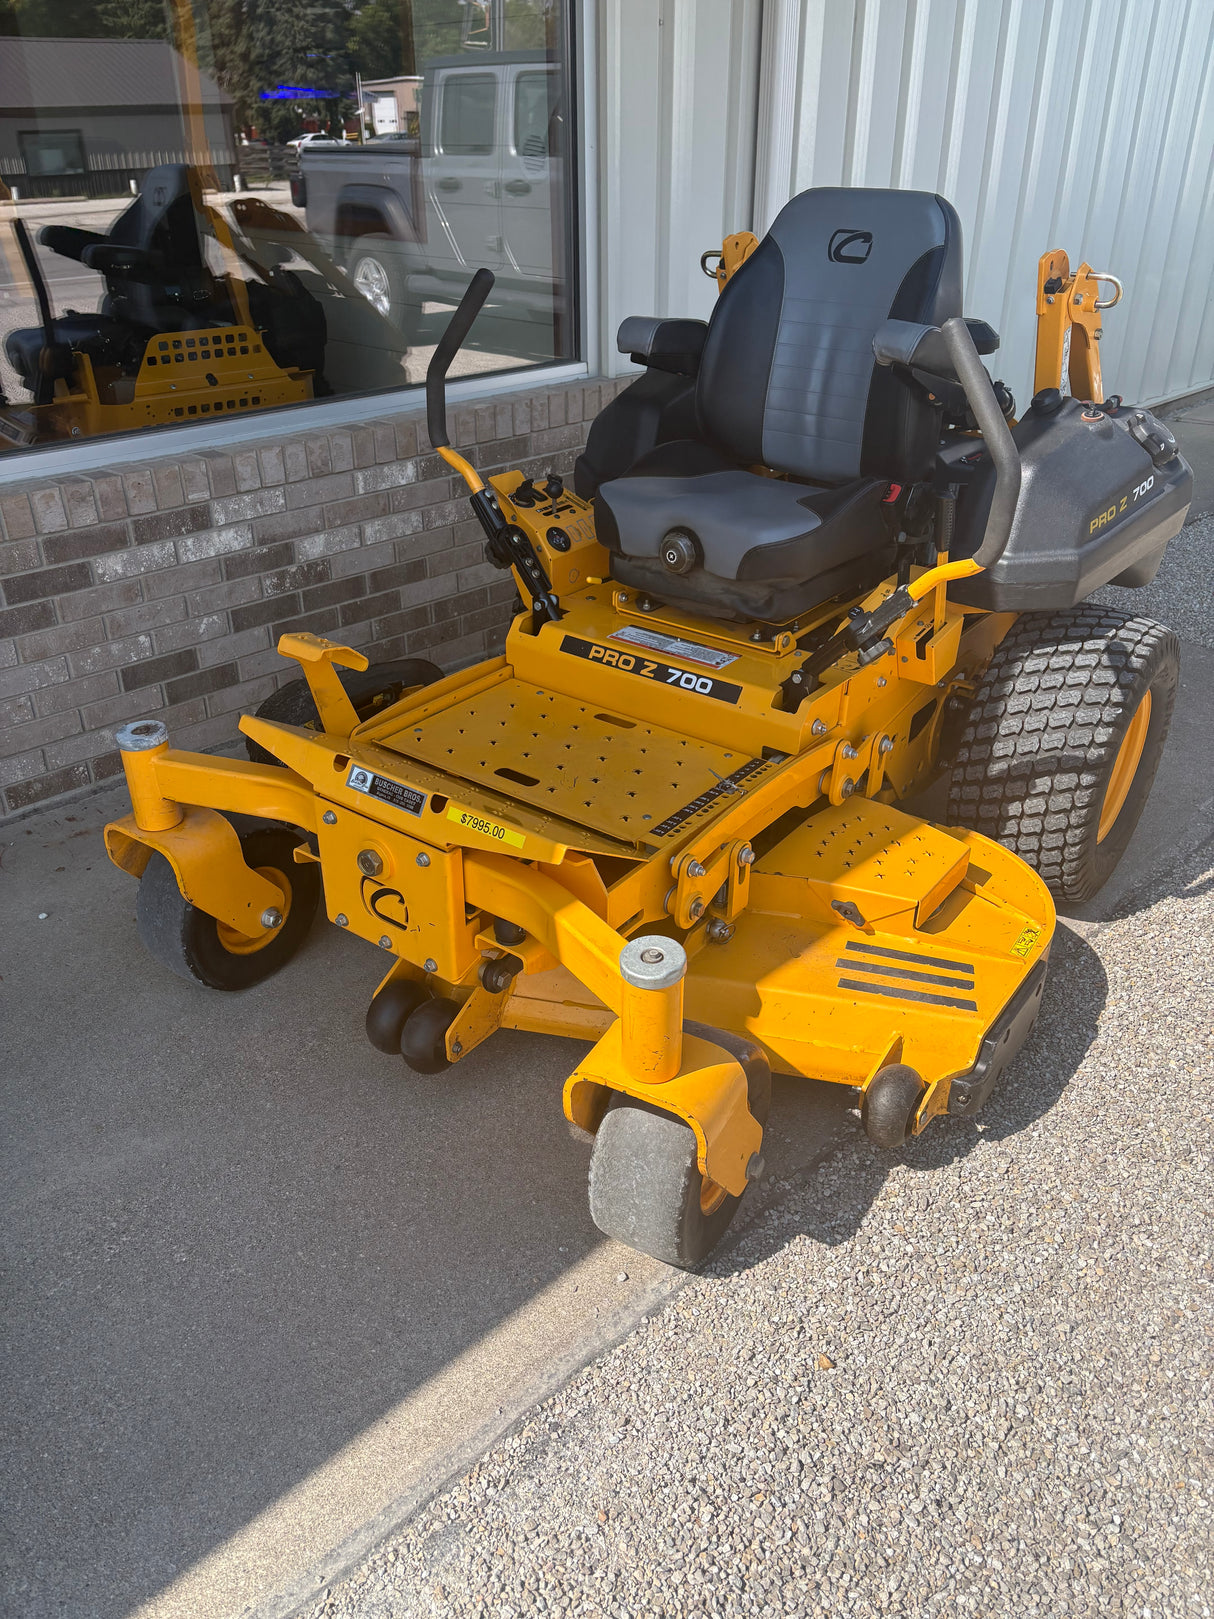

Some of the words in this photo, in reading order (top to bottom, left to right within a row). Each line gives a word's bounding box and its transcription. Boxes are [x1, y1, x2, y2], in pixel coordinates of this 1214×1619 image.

[1089, 505, 1116, 534] PRO
[1119, 496, 1127, 512] Z
[1132, 474, 1154, 501] 700
[588, 645, 635, 671] PRO
[640, 662, 658, 677] Z
[666, 668, 713, 694] 700
[374, 778, 403, 796] BUSCHER
[403, 790, 422, 804] BROS.
[460, 813, 506, 840] $7995.00
